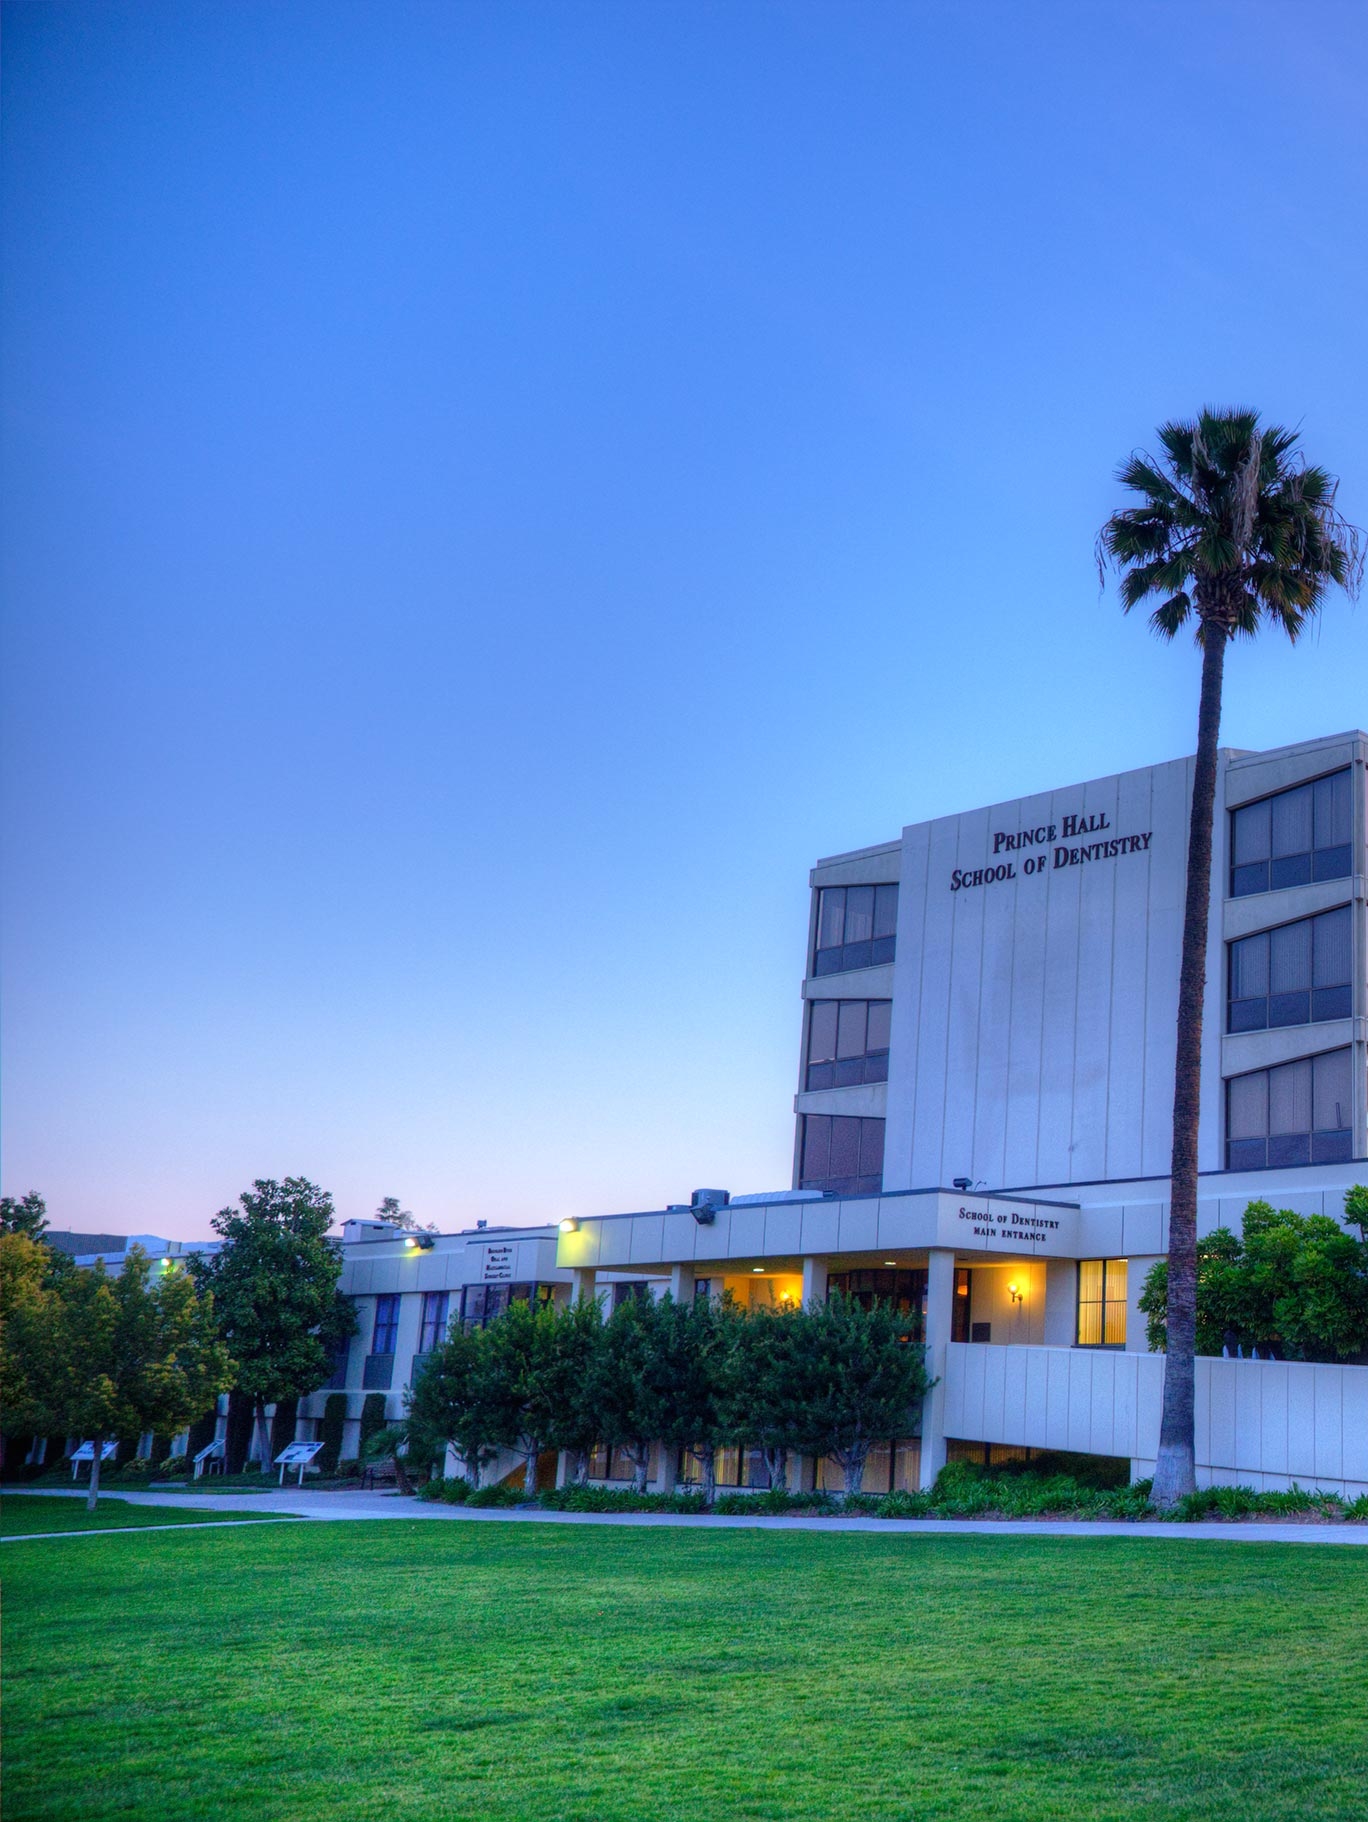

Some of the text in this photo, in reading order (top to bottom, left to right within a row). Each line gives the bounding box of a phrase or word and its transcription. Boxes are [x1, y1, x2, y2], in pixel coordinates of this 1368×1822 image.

[993, 813, 1110, 854] PRINCE HALL
[950, 832, 1153, 891] SCHOOL OF DENTISTRY
[959, 1208, 1059, 1229] SCHOOL OF DENTISTRY
[974, 1227, 1046, 1241] MAIN ENTRANCE
